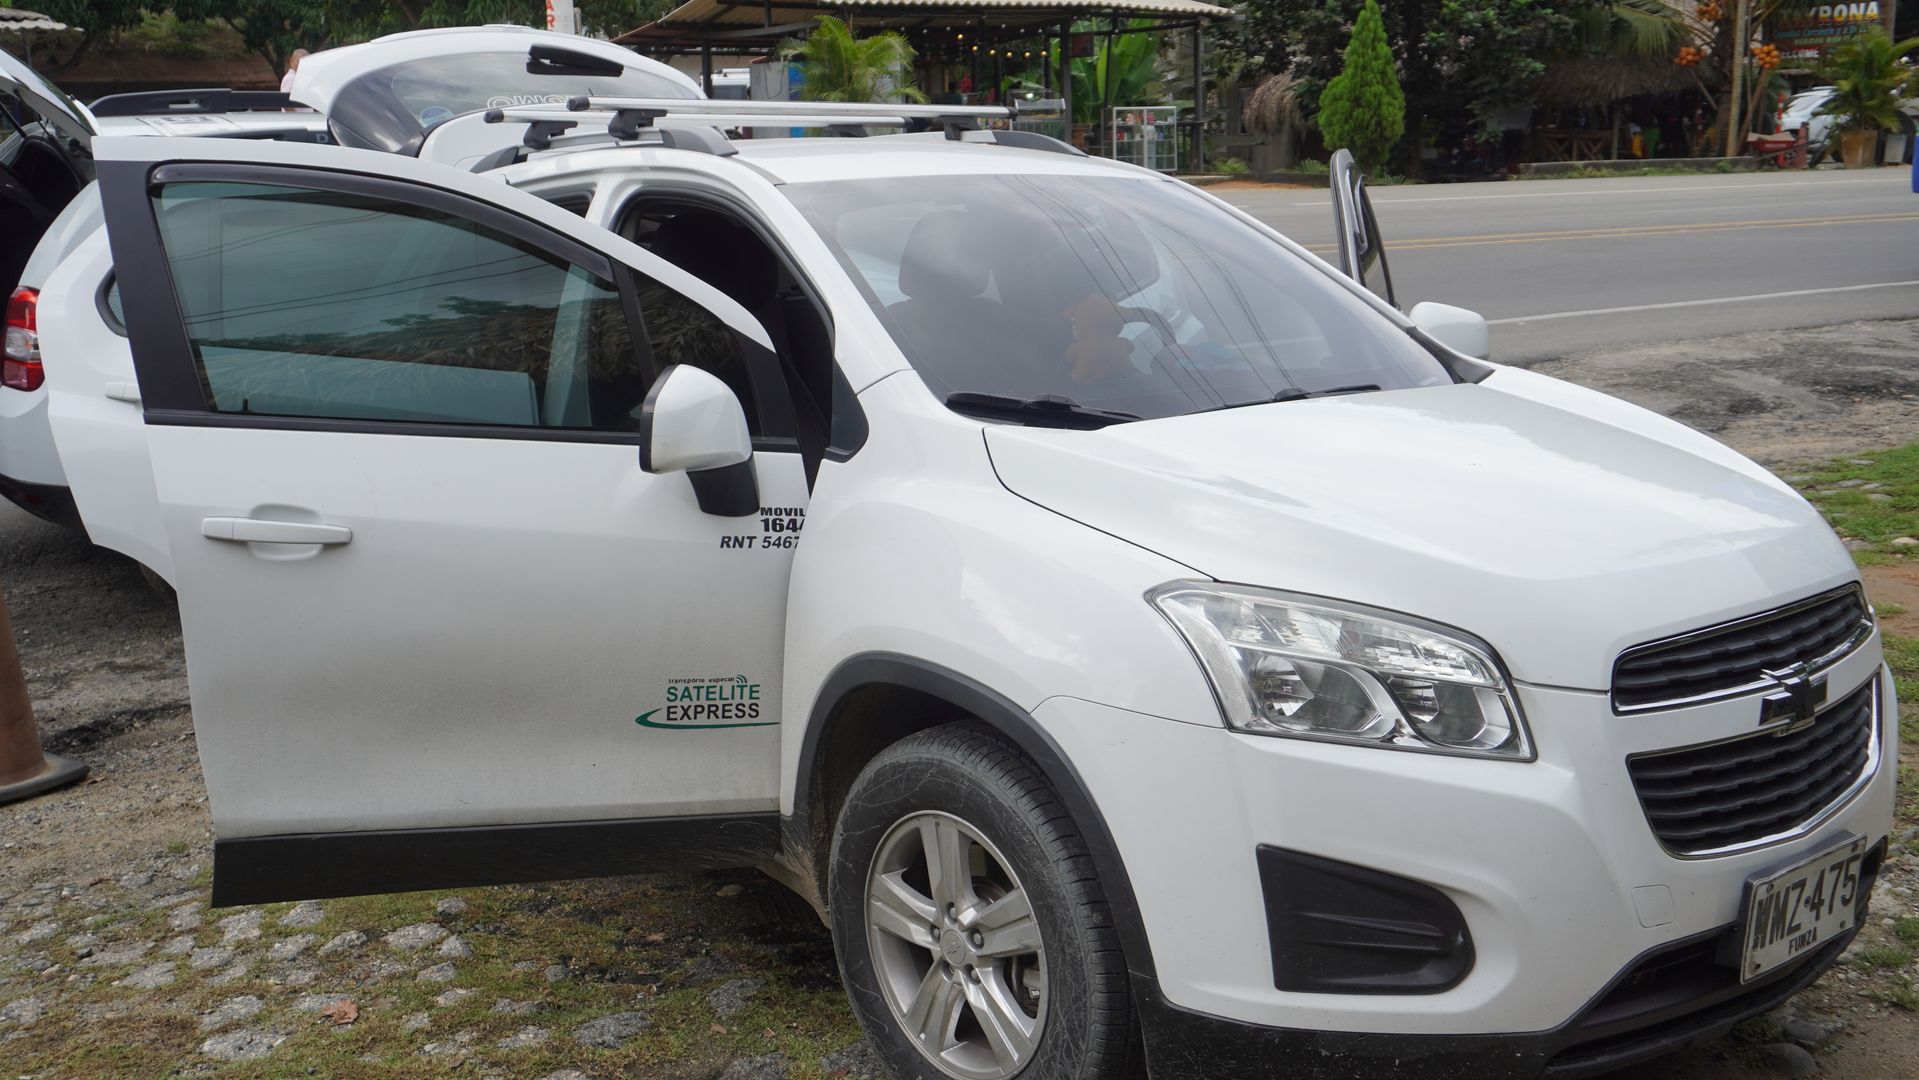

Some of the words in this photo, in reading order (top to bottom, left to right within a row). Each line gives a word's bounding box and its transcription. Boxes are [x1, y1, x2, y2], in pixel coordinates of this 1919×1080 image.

[760, 507, 806, 517] MOVIL
[720, 535, 757, 549] RNT
[666, 684, 760, 702] SATELITE
[666, 703, 760, 721] EXPRESS
[1788, 926, 1817, 955] FUNZA
